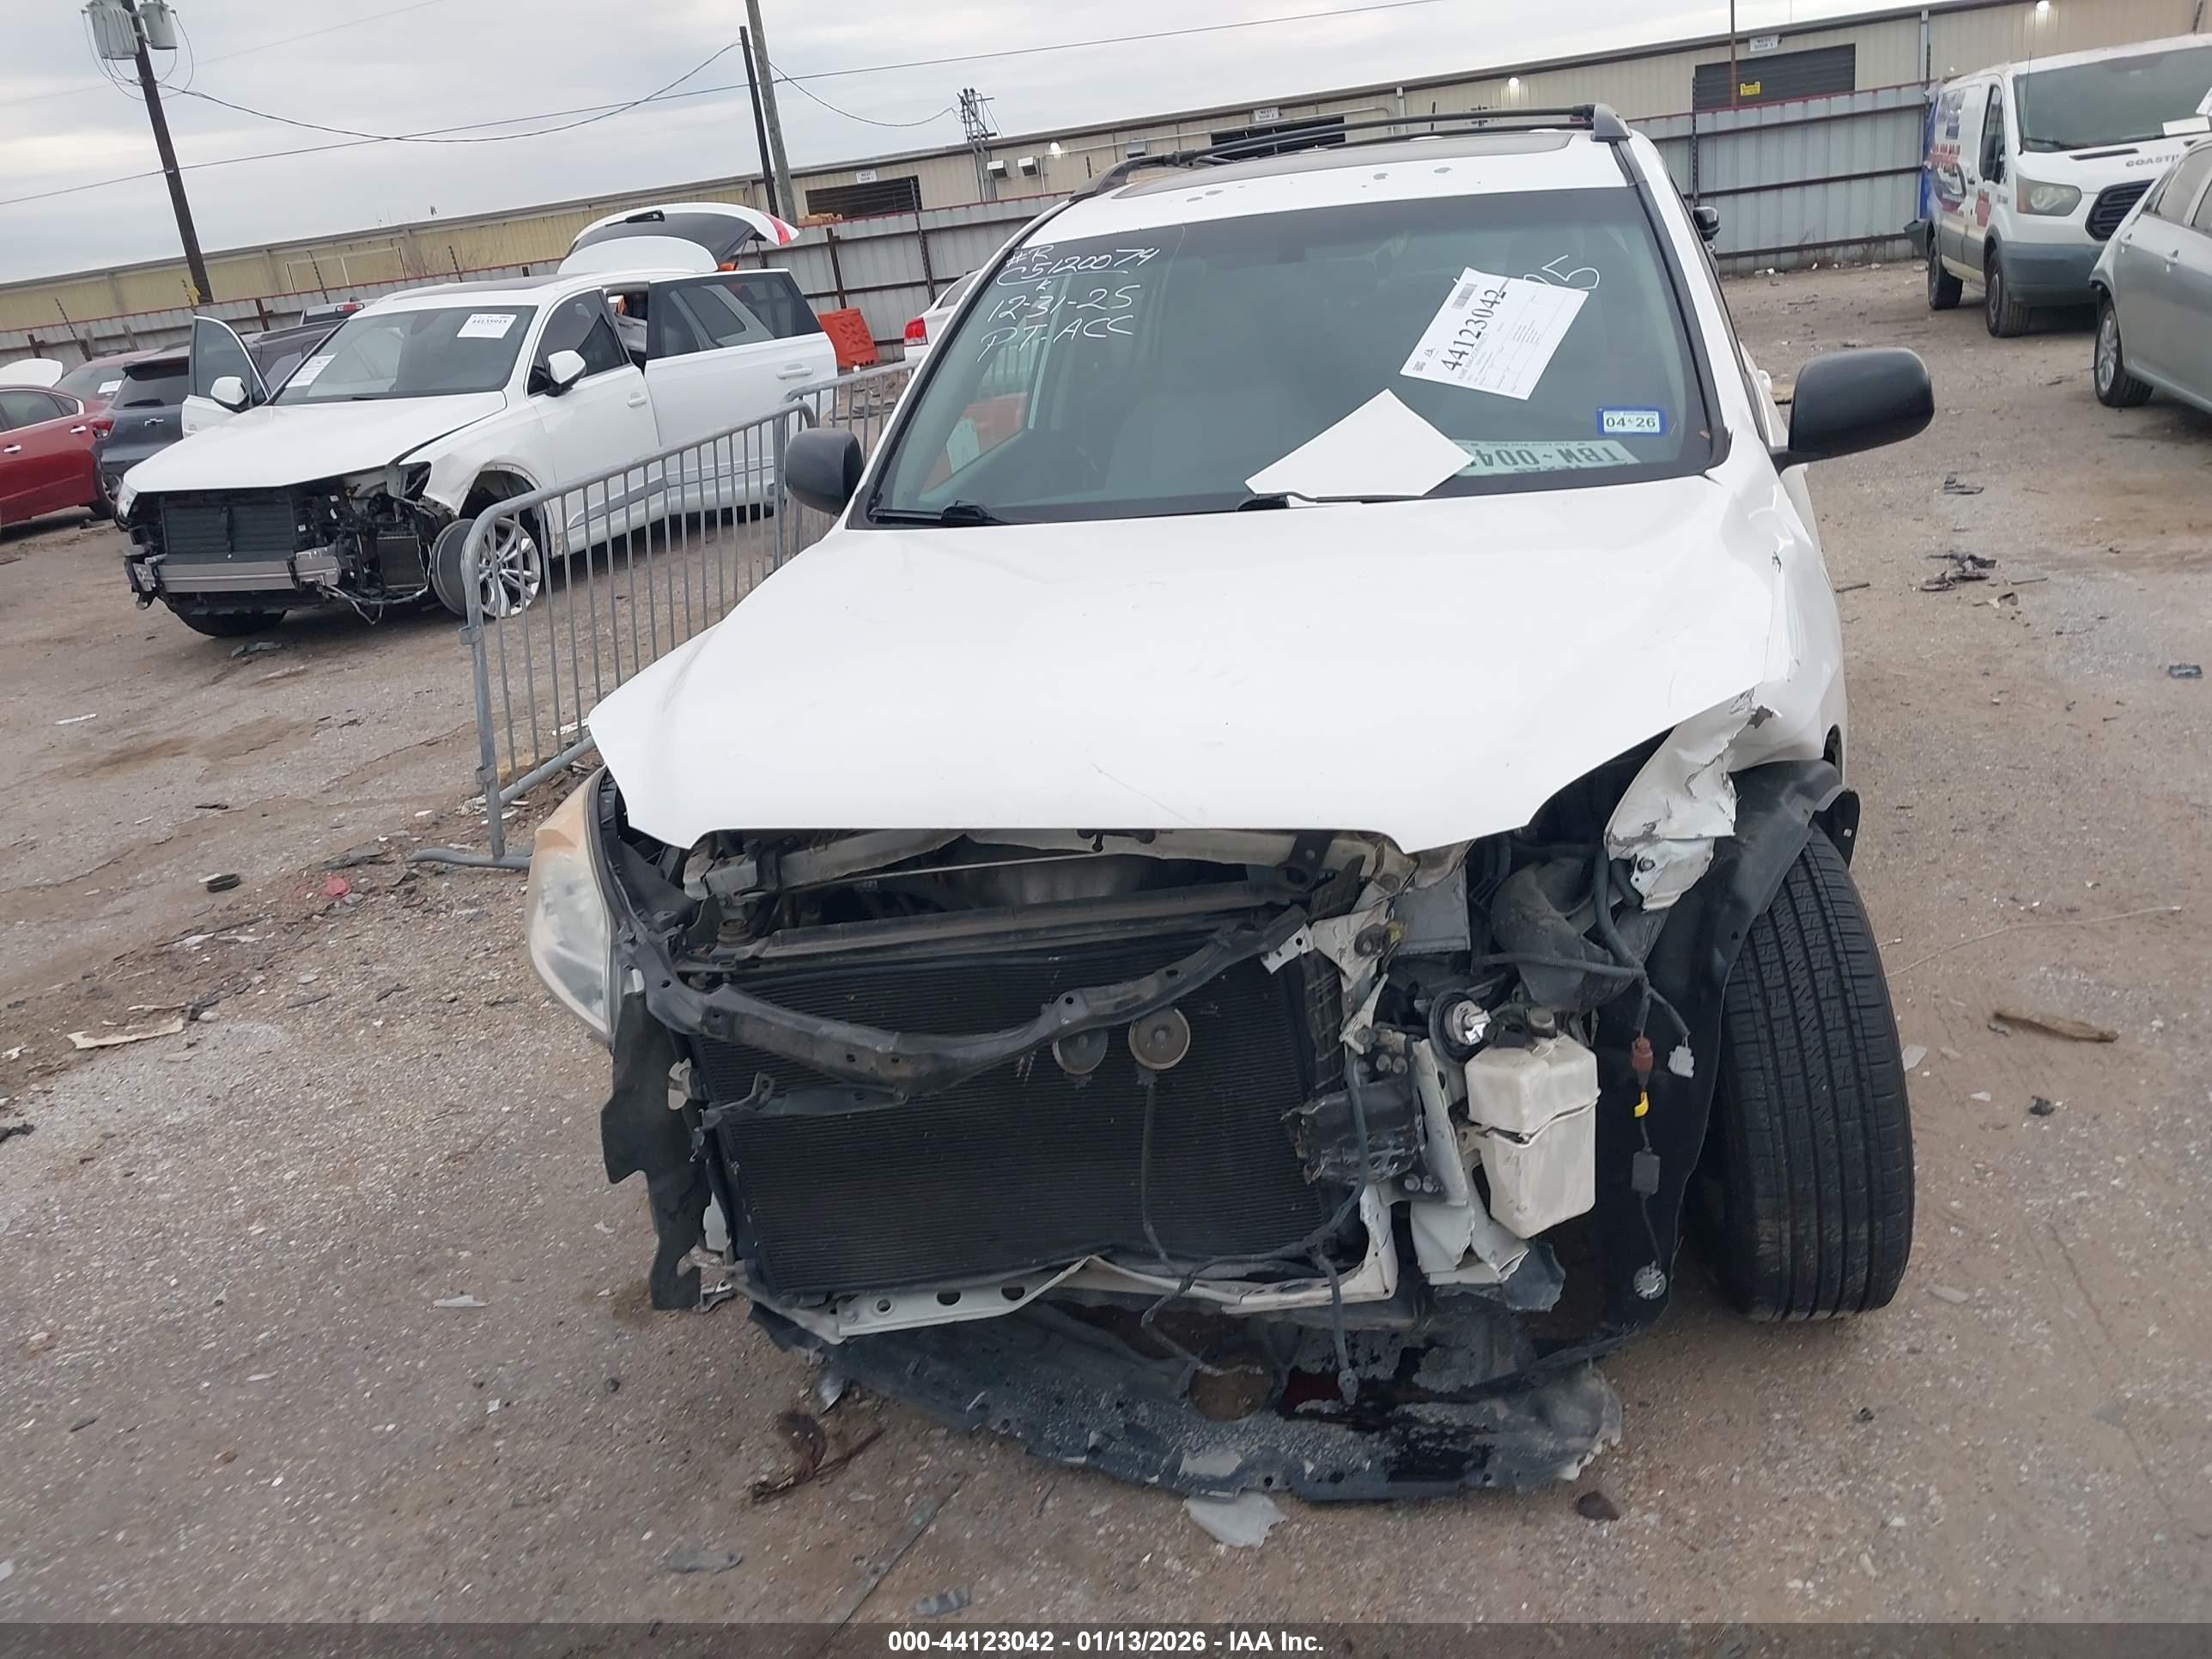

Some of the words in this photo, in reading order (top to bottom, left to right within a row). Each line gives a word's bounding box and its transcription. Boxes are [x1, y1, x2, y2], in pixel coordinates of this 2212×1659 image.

[987, 284, 1142, 323] 12-31-25
[1441, 289, 1507, 372] 44123042
[1606, 416, 1626, 428] 04
[1635, 416, 1656, 428] 26
